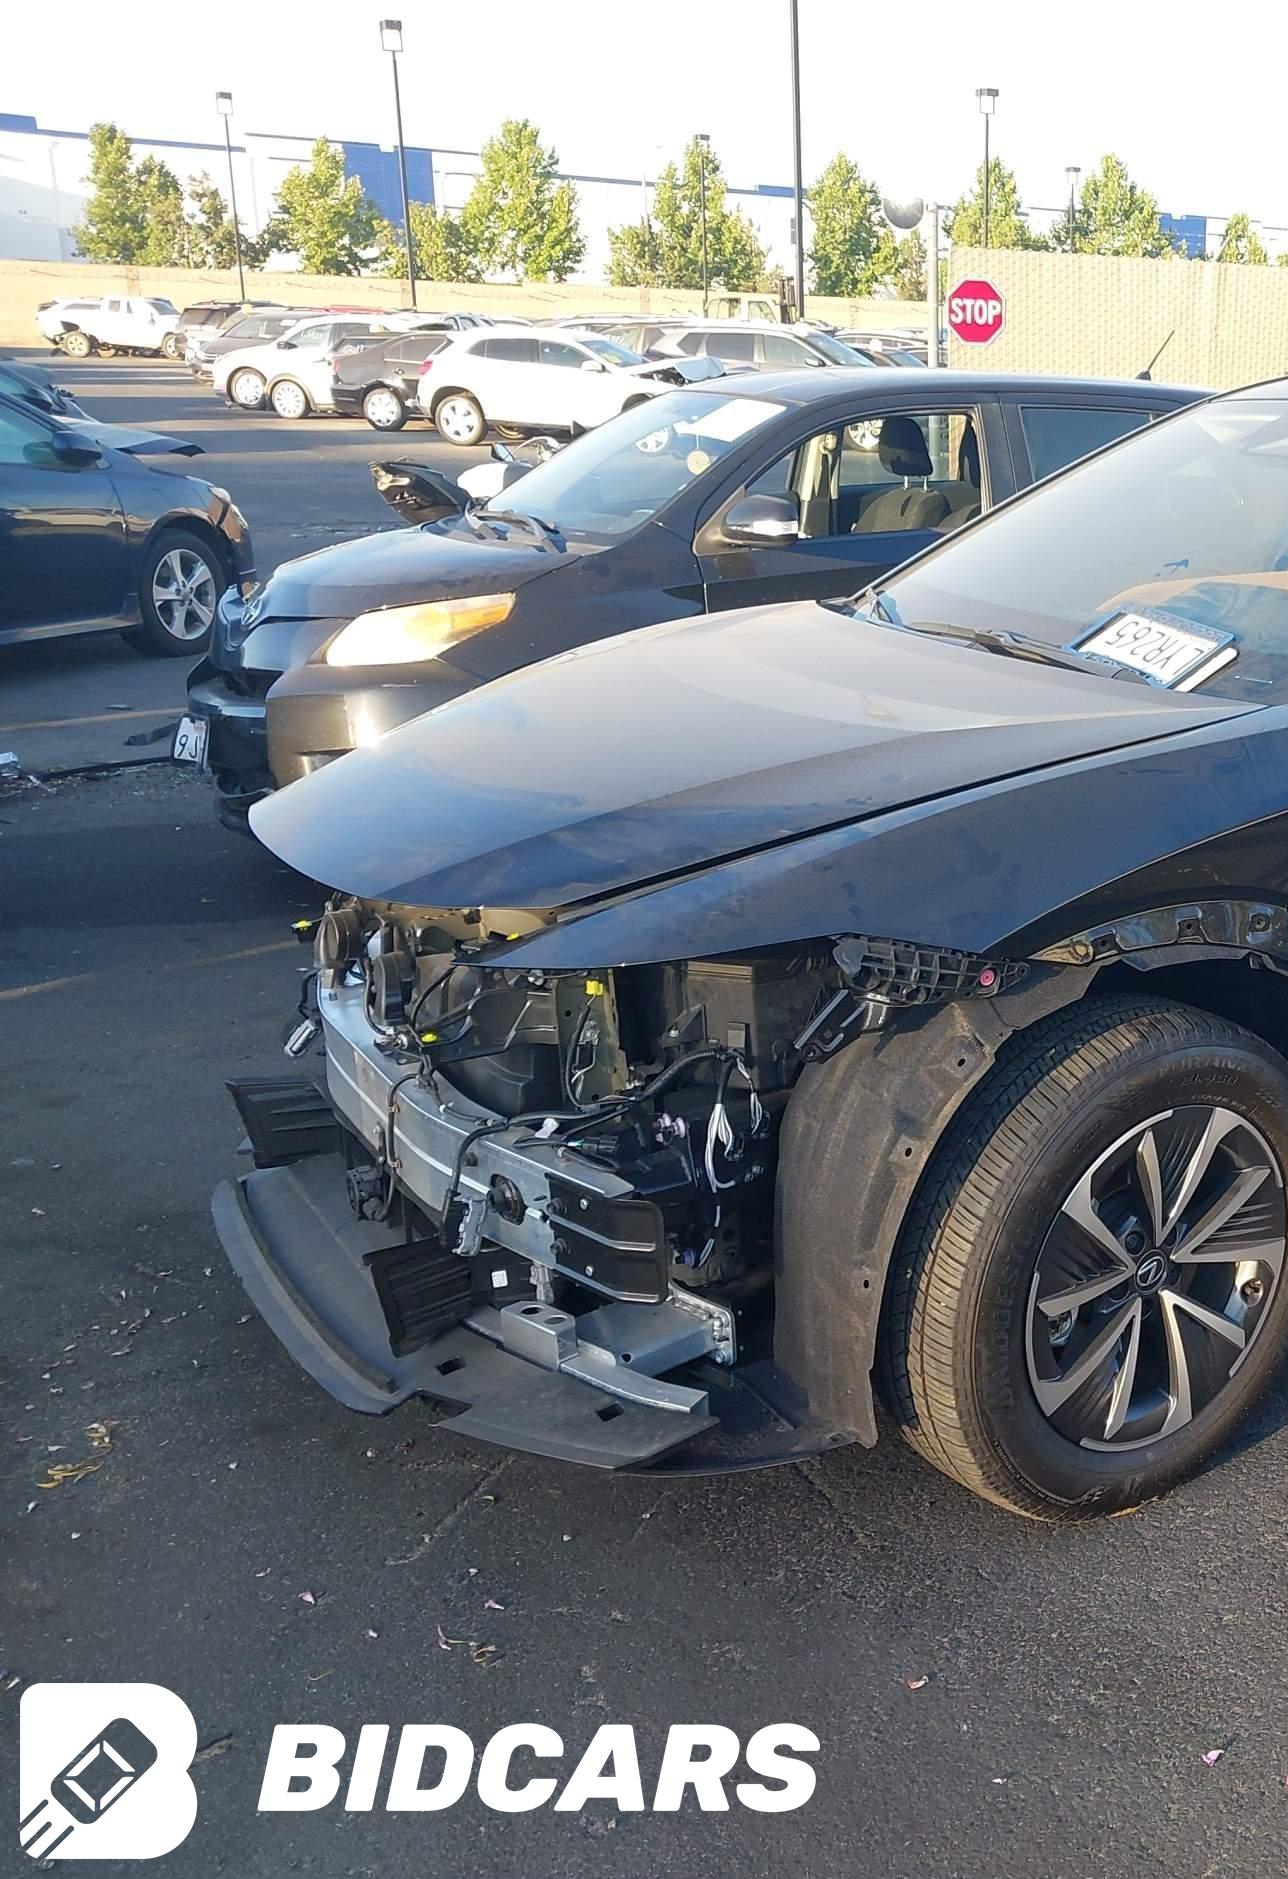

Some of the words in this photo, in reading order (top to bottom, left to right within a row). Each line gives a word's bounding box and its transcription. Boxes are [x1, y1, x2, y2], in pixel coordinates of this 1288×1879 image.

[950, 297, 1001, 325] STOP
[1104, 620, 1205, 676] LYR265
[177, 734, 202, 759] 9J
